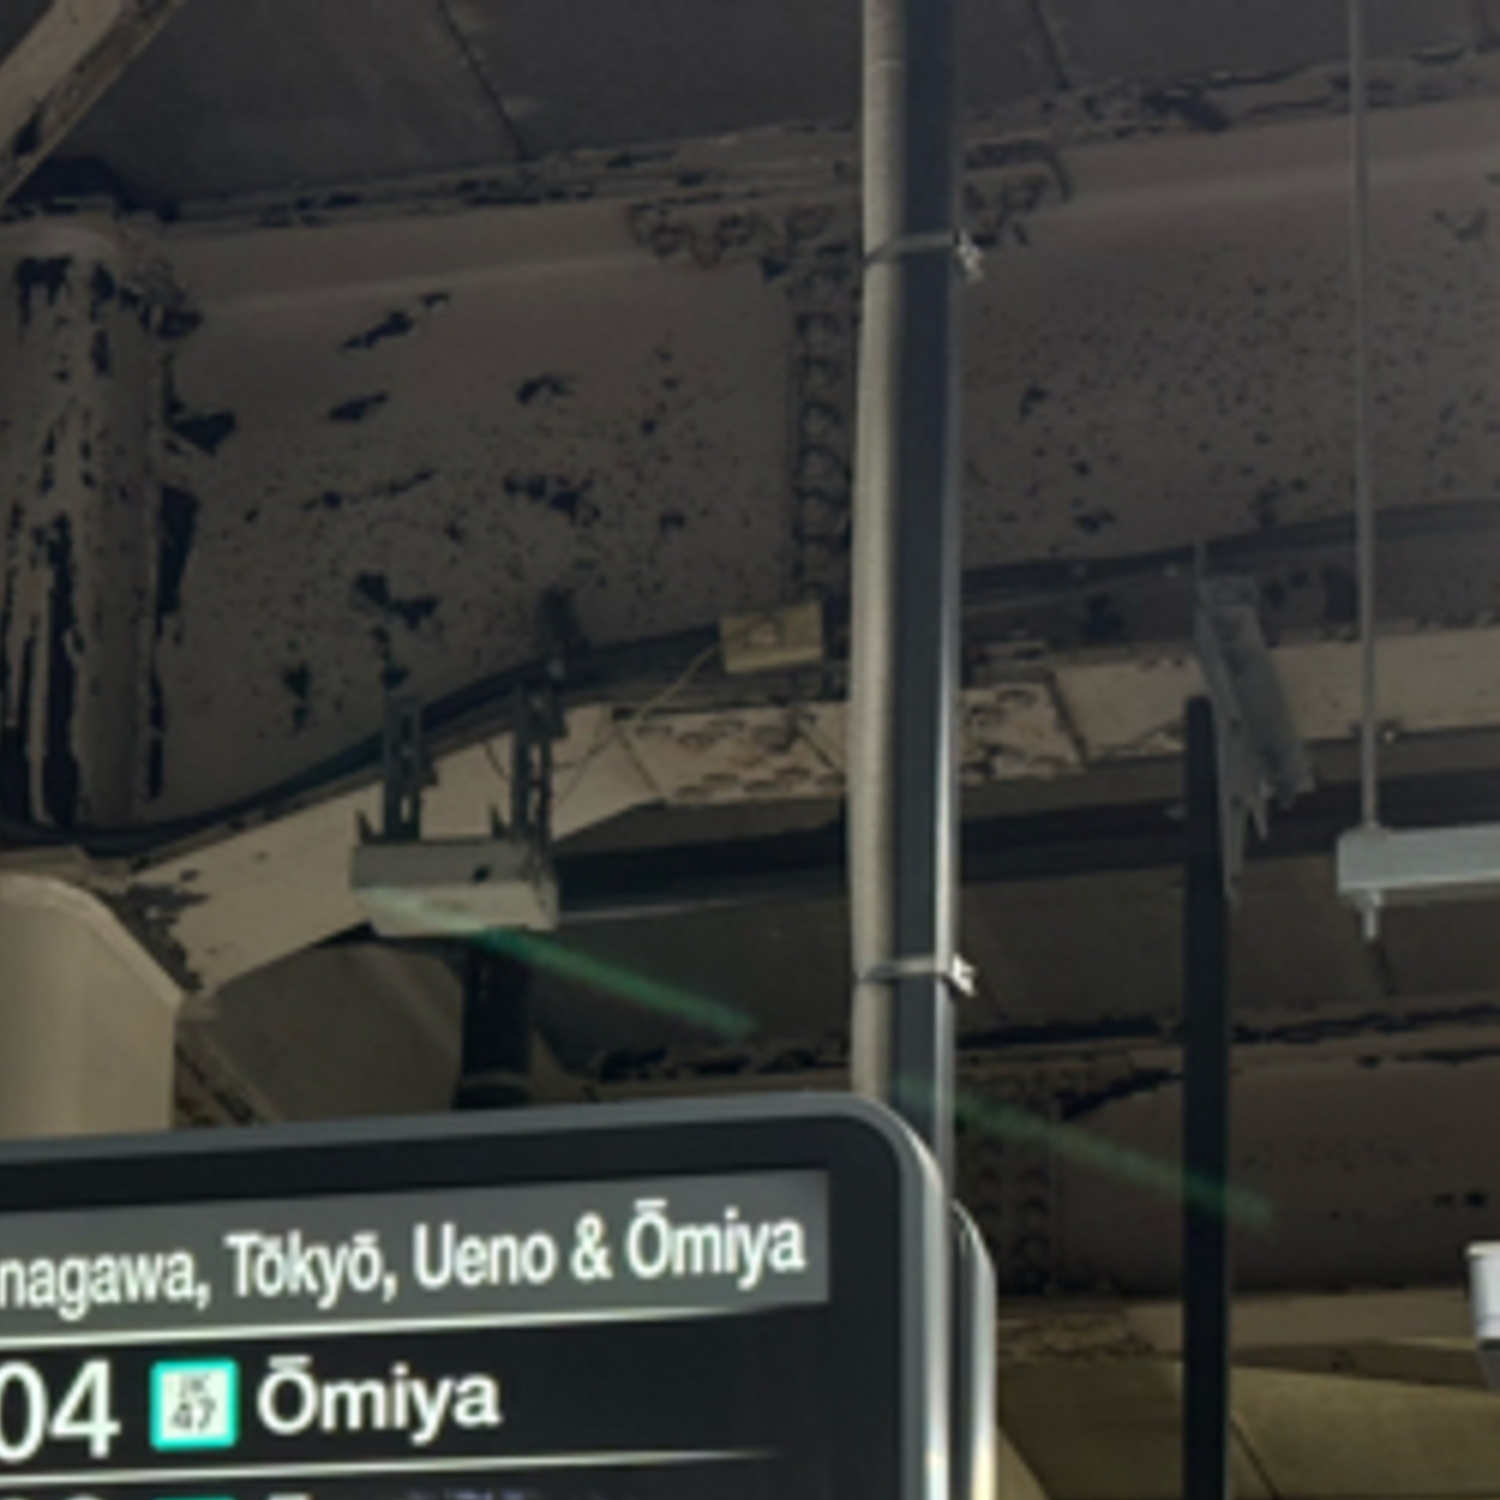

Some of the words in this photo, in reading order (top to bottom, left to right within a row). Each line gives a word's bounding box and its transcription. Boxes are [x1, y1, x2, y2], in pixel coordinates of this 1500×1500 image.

[223, 1228, 397, 1310] Tōkyō,
[412, 1222, 558, 1289] Ueno
[571, 1211, 613, 1282] &
[626, 1198, 807, 1292] Ōmiya
[257, 1354, 502, 1446] Ōmiya
